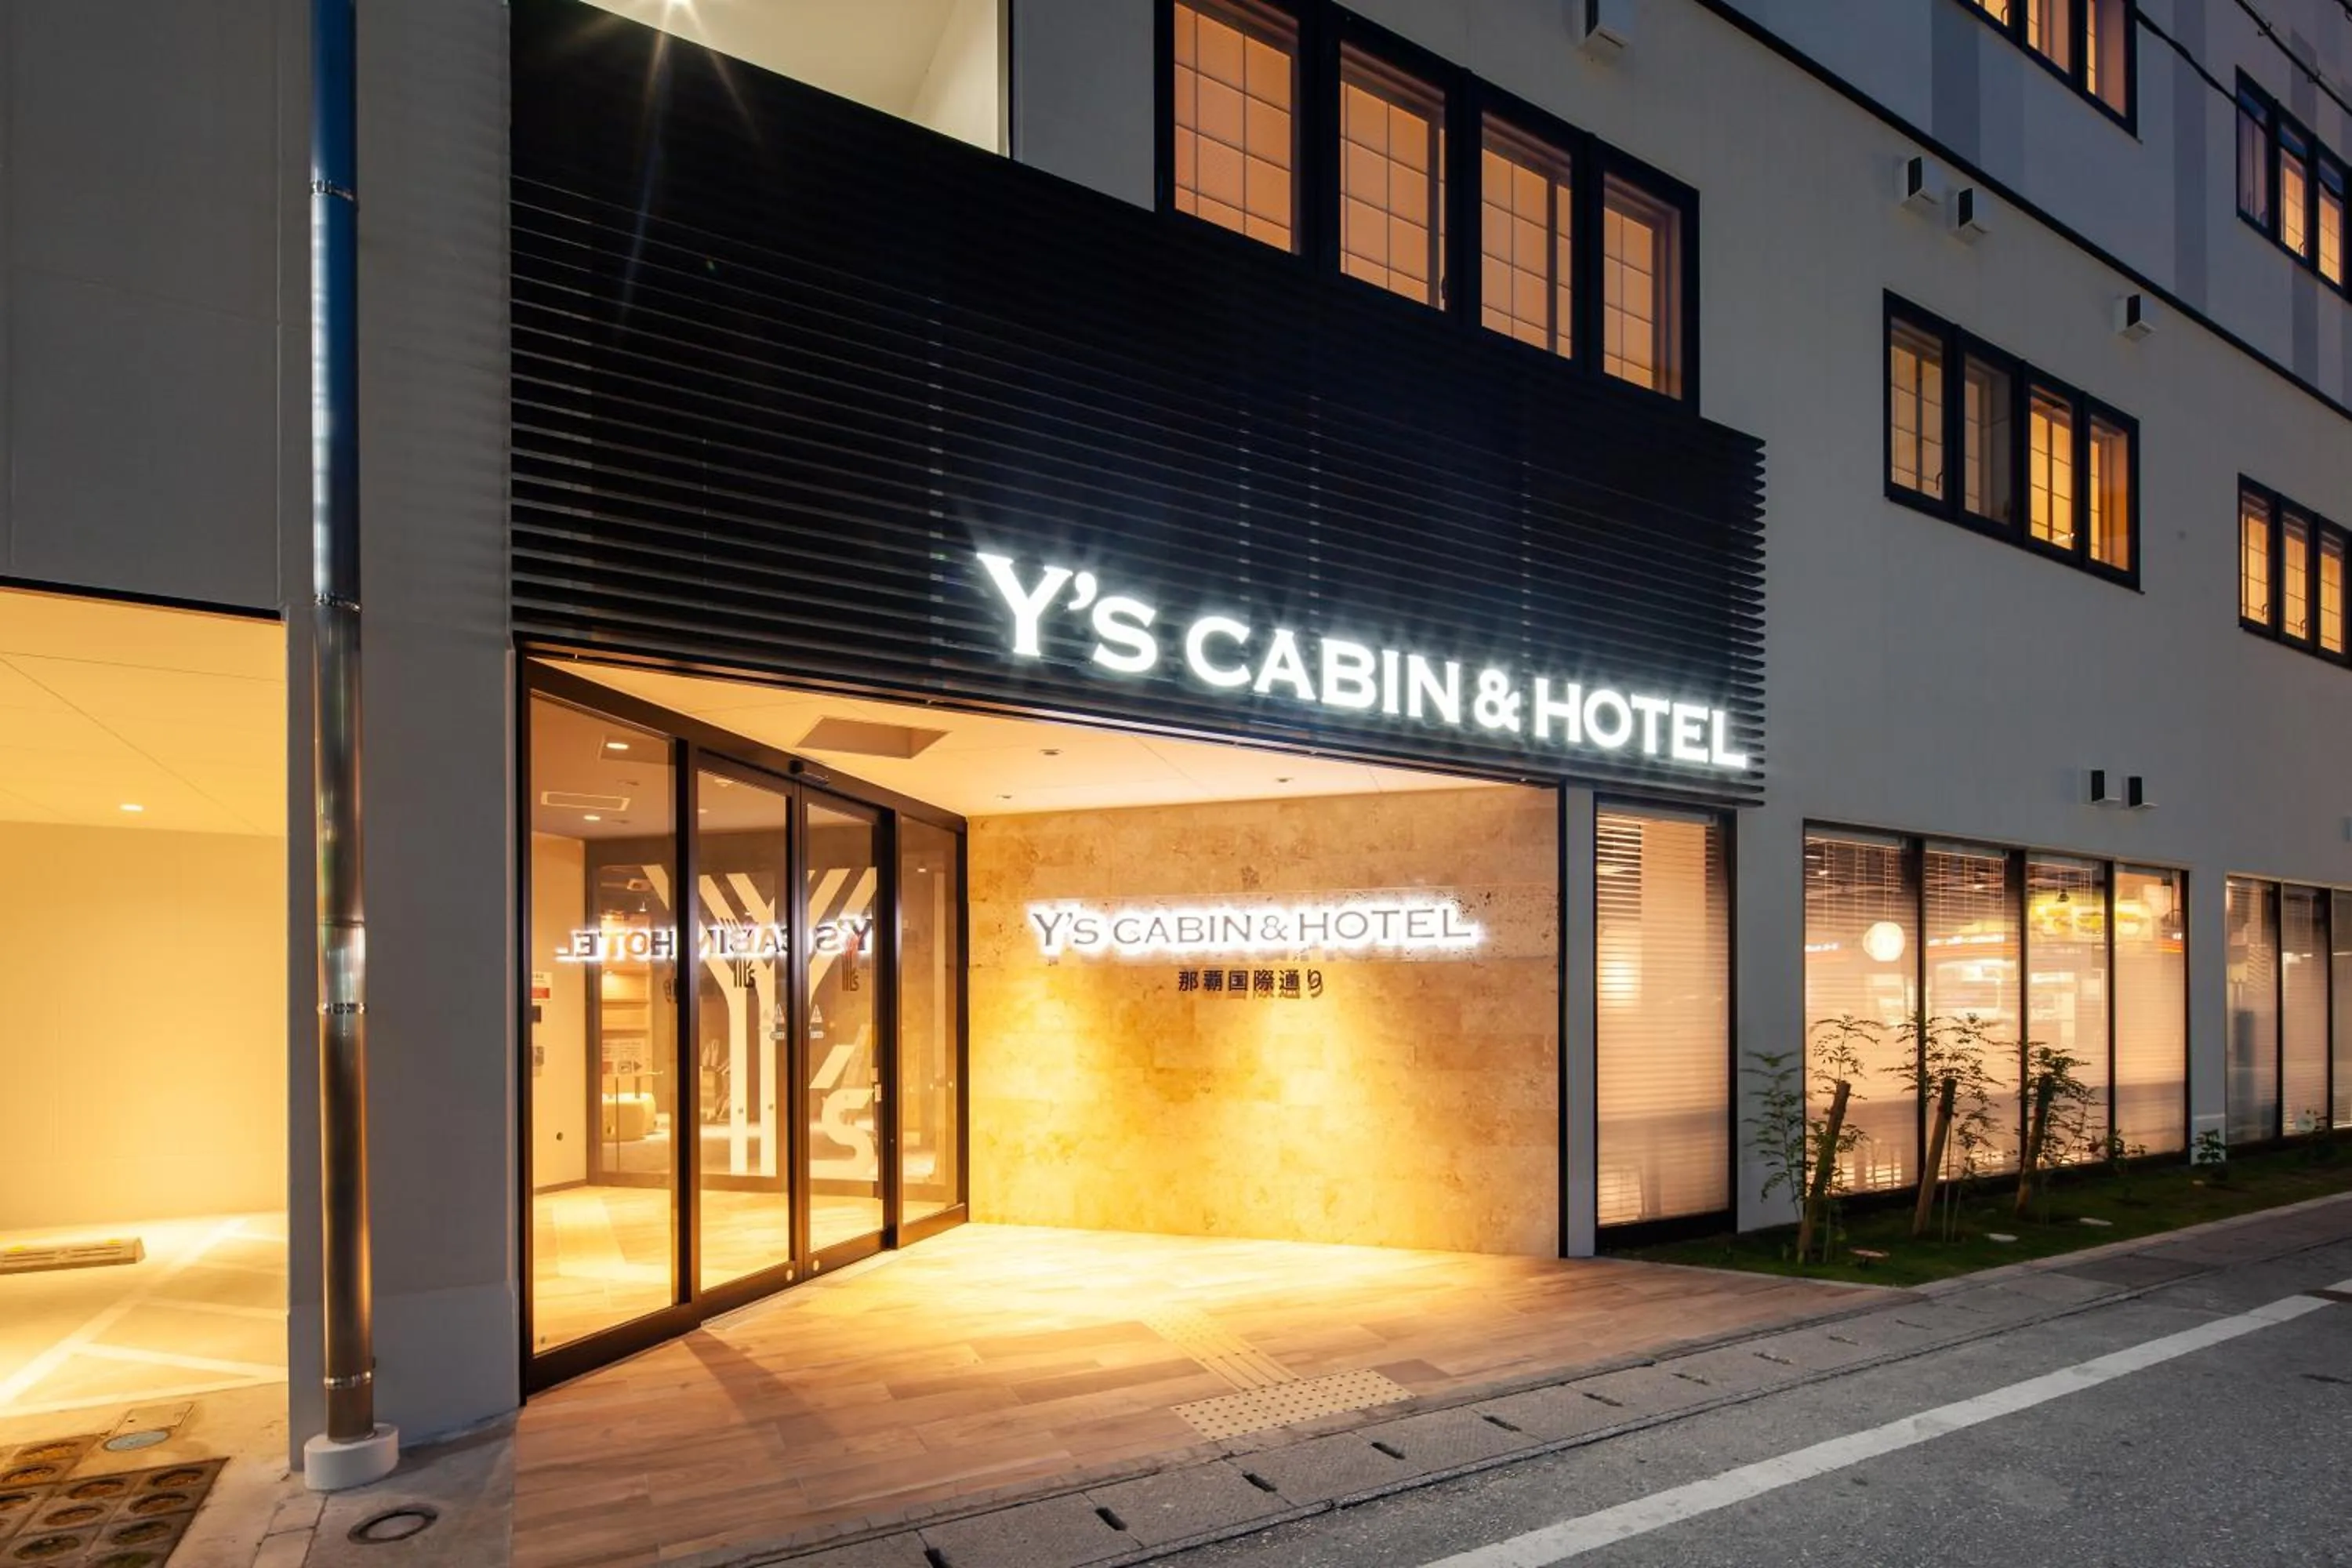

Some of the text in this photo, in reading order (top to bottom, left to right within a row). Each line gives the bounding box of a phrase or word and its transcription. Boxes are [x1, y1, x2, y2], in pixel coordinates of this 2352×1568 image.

[1185, 615, 1461, 724] CABIN
[1534, 677, 1748, 769] HOTEL
[1178, 969, 1323, 993] 那覇国際通り
